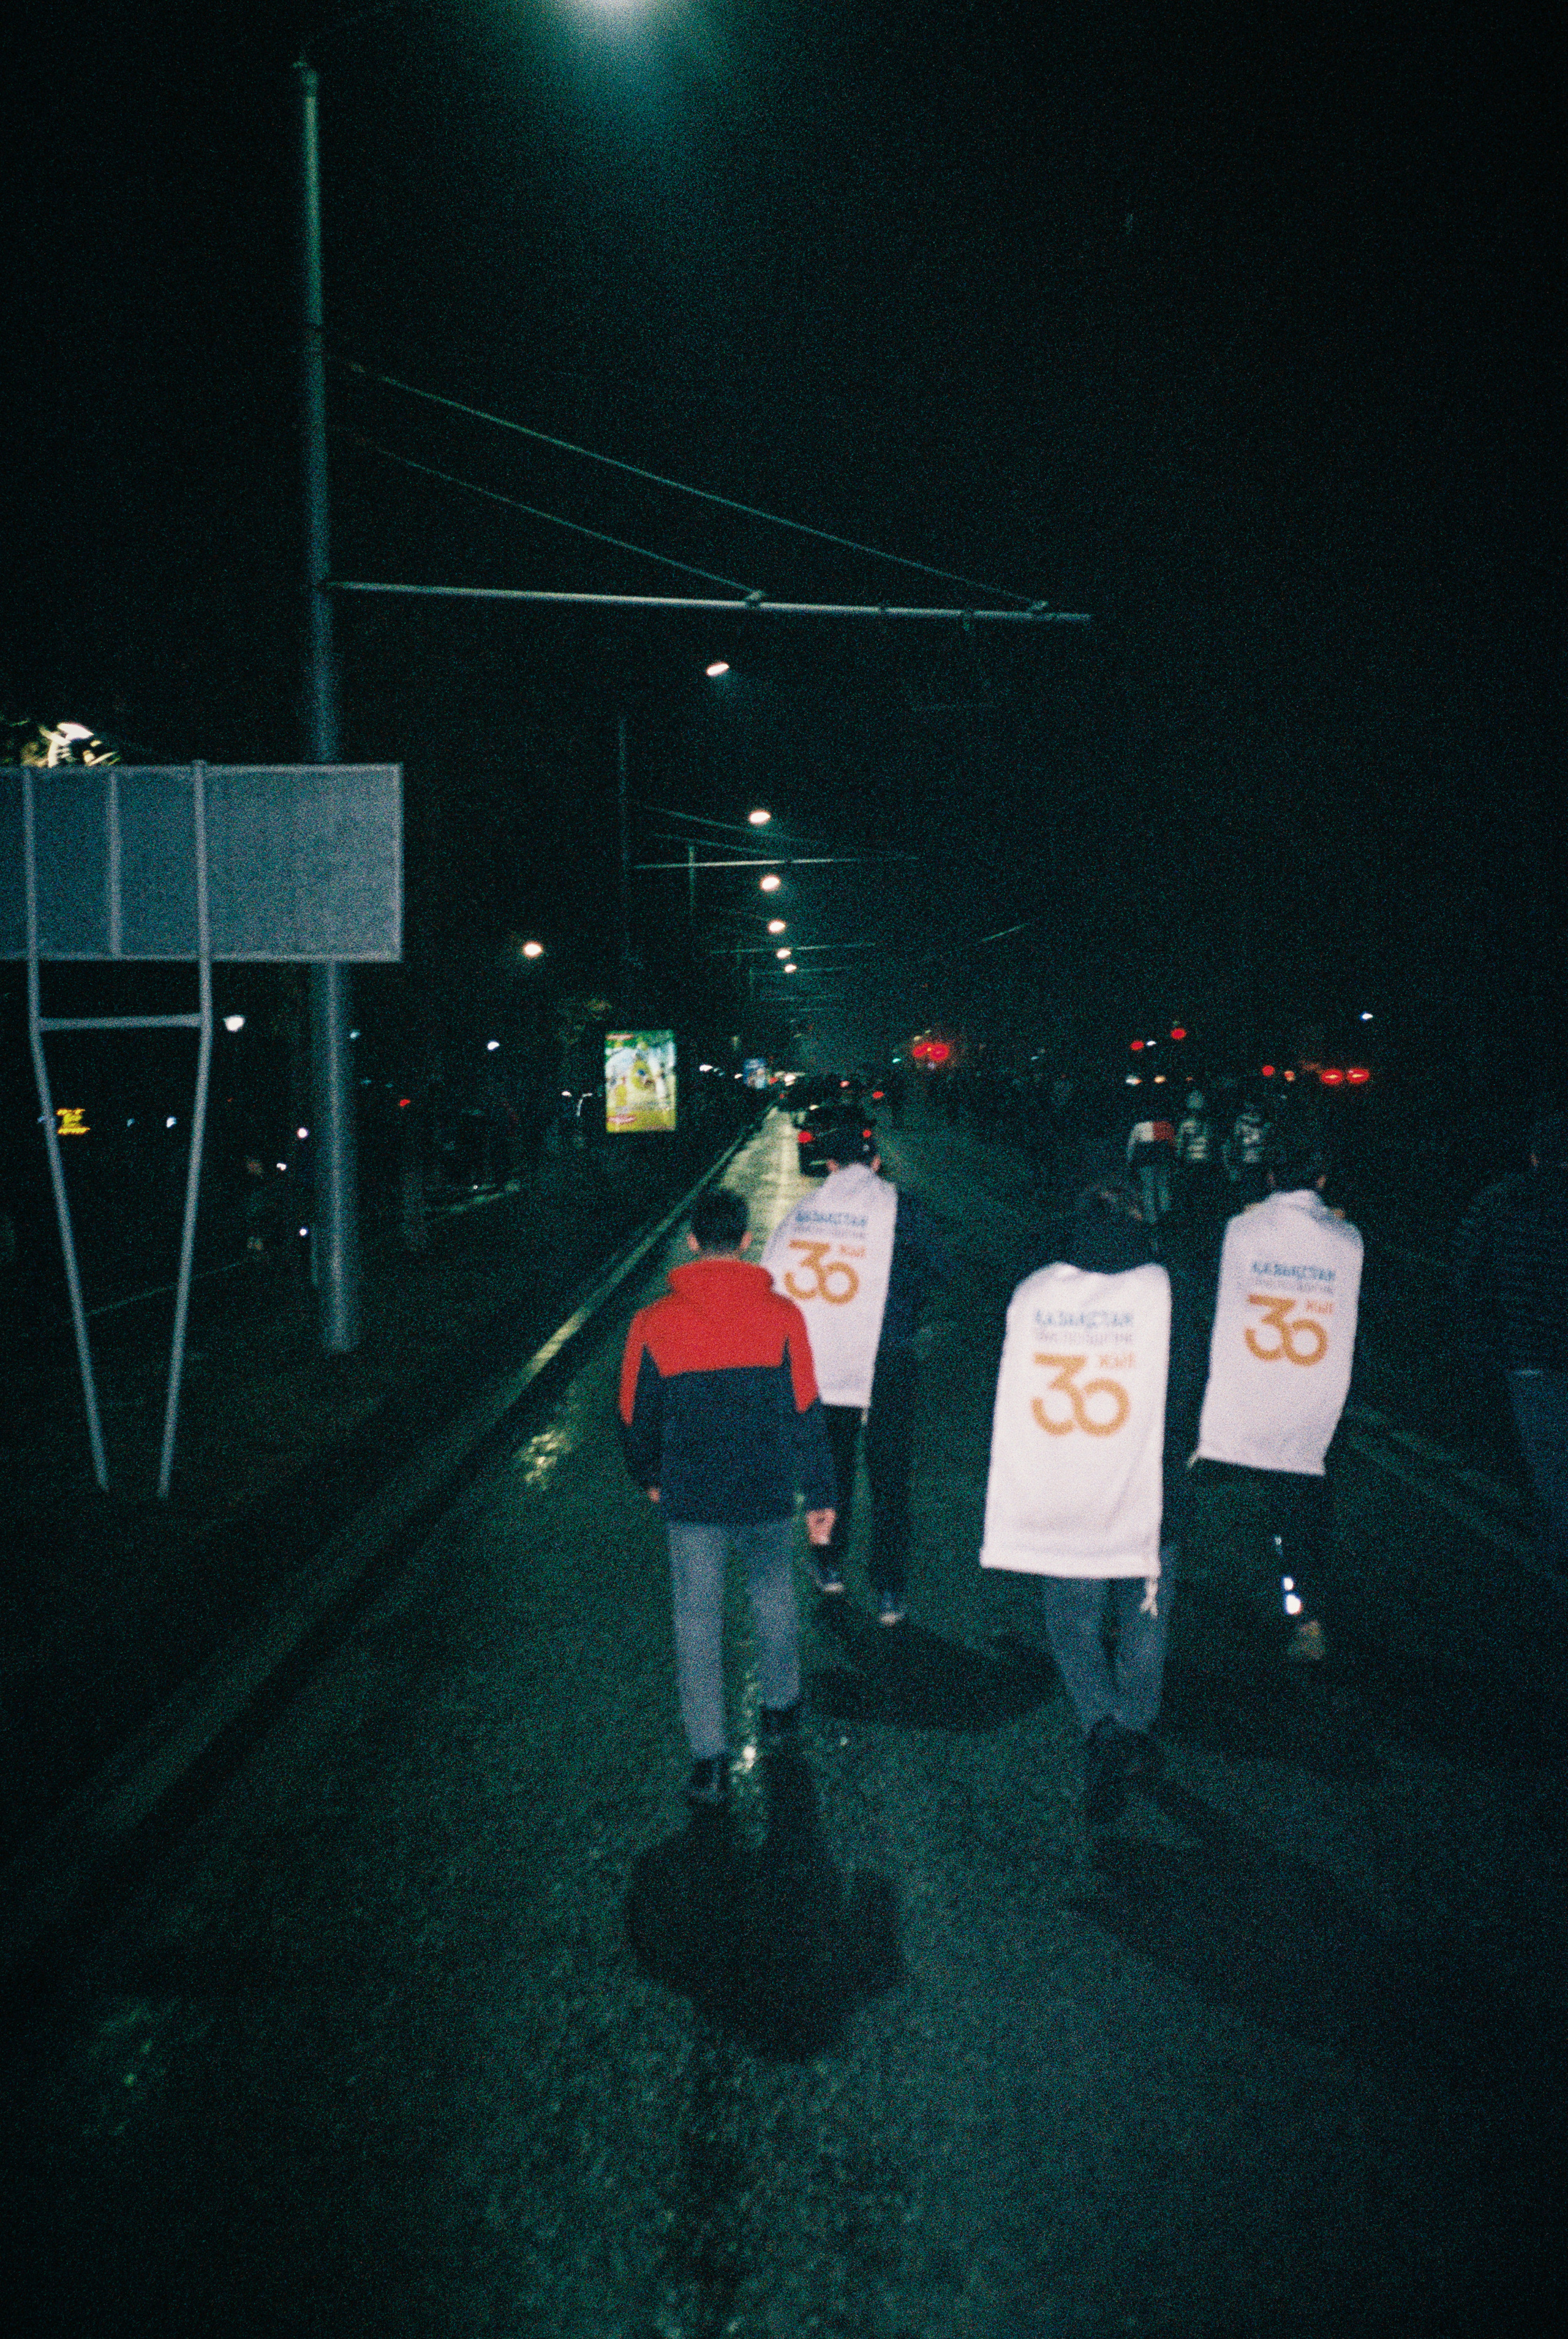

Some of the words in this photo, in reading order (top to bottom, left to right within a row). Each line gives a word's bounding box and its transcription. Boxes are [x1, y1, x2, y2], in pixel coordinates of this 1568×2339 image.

[783, 1239, 860, 1306] 30
[1244, 1294, 1329, 1366] 30
[1030, 1352, 1132, 1437] 30
